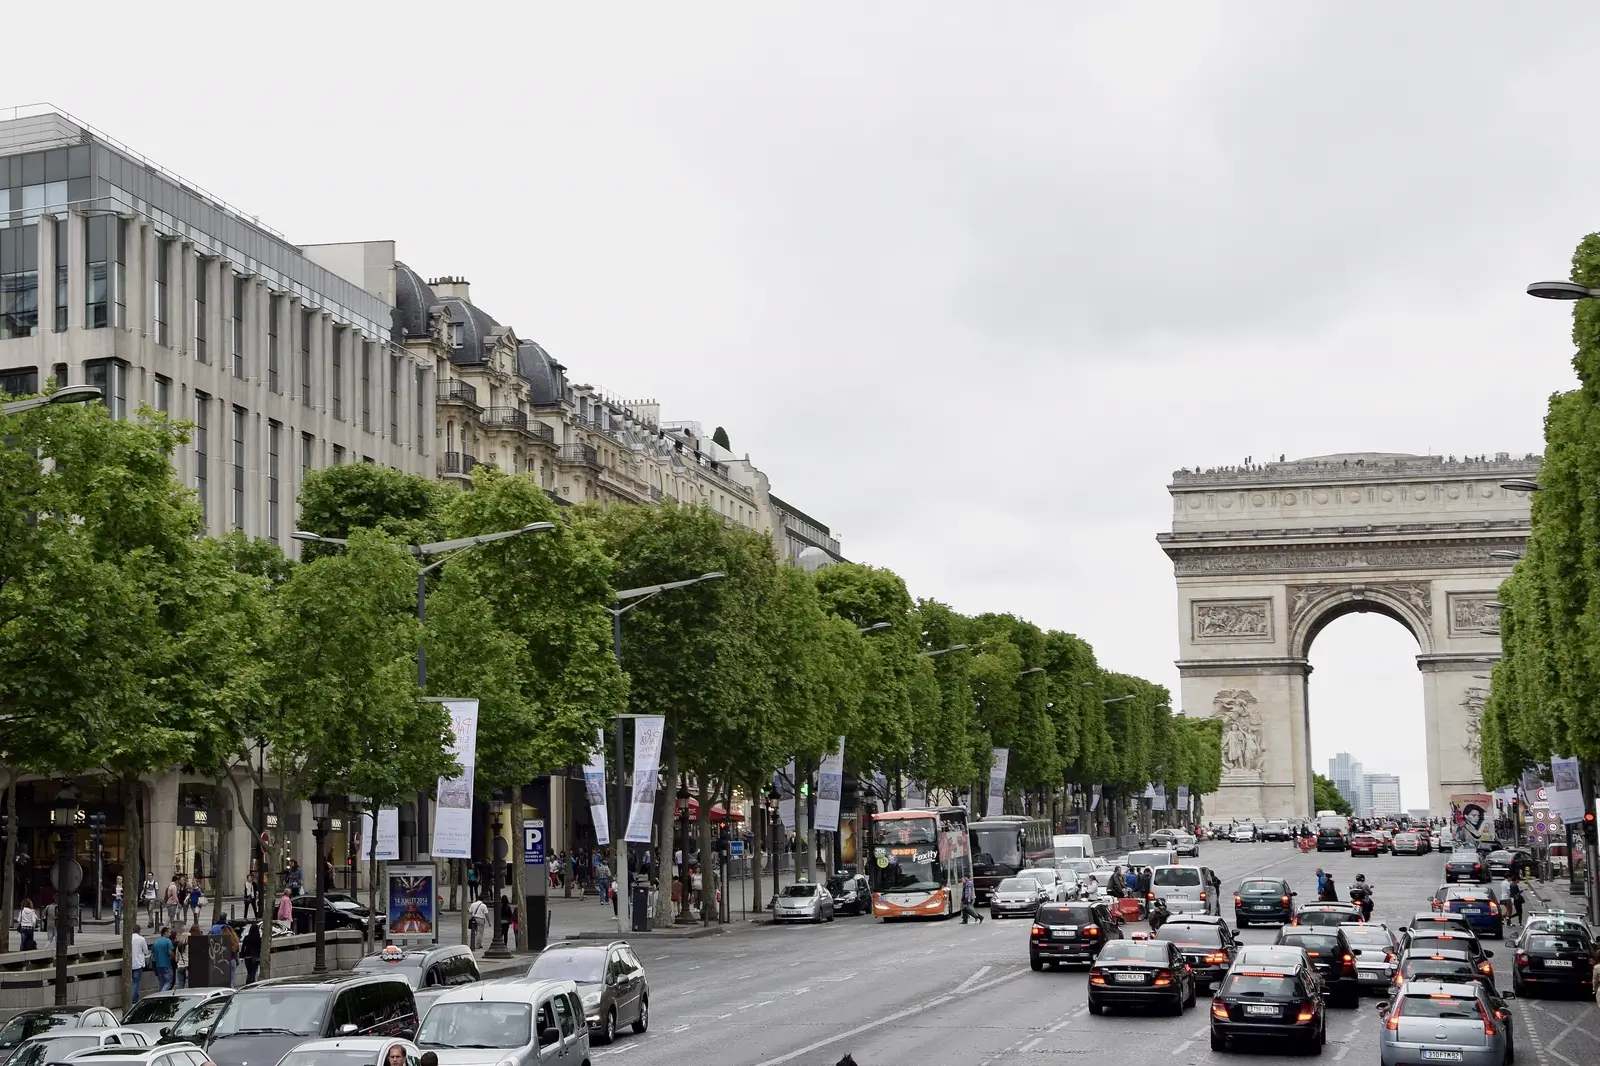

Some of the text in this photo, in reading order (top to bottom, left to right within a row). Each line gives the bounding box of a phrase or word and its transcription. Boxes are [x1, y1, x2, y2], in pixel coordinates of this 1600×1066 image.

[194, 811, 208, 821] BOSS
[266, 815, 278, 825] BOSS
[526, 829, 542, 850] P
[912, 850, 939, 862] Foxity
